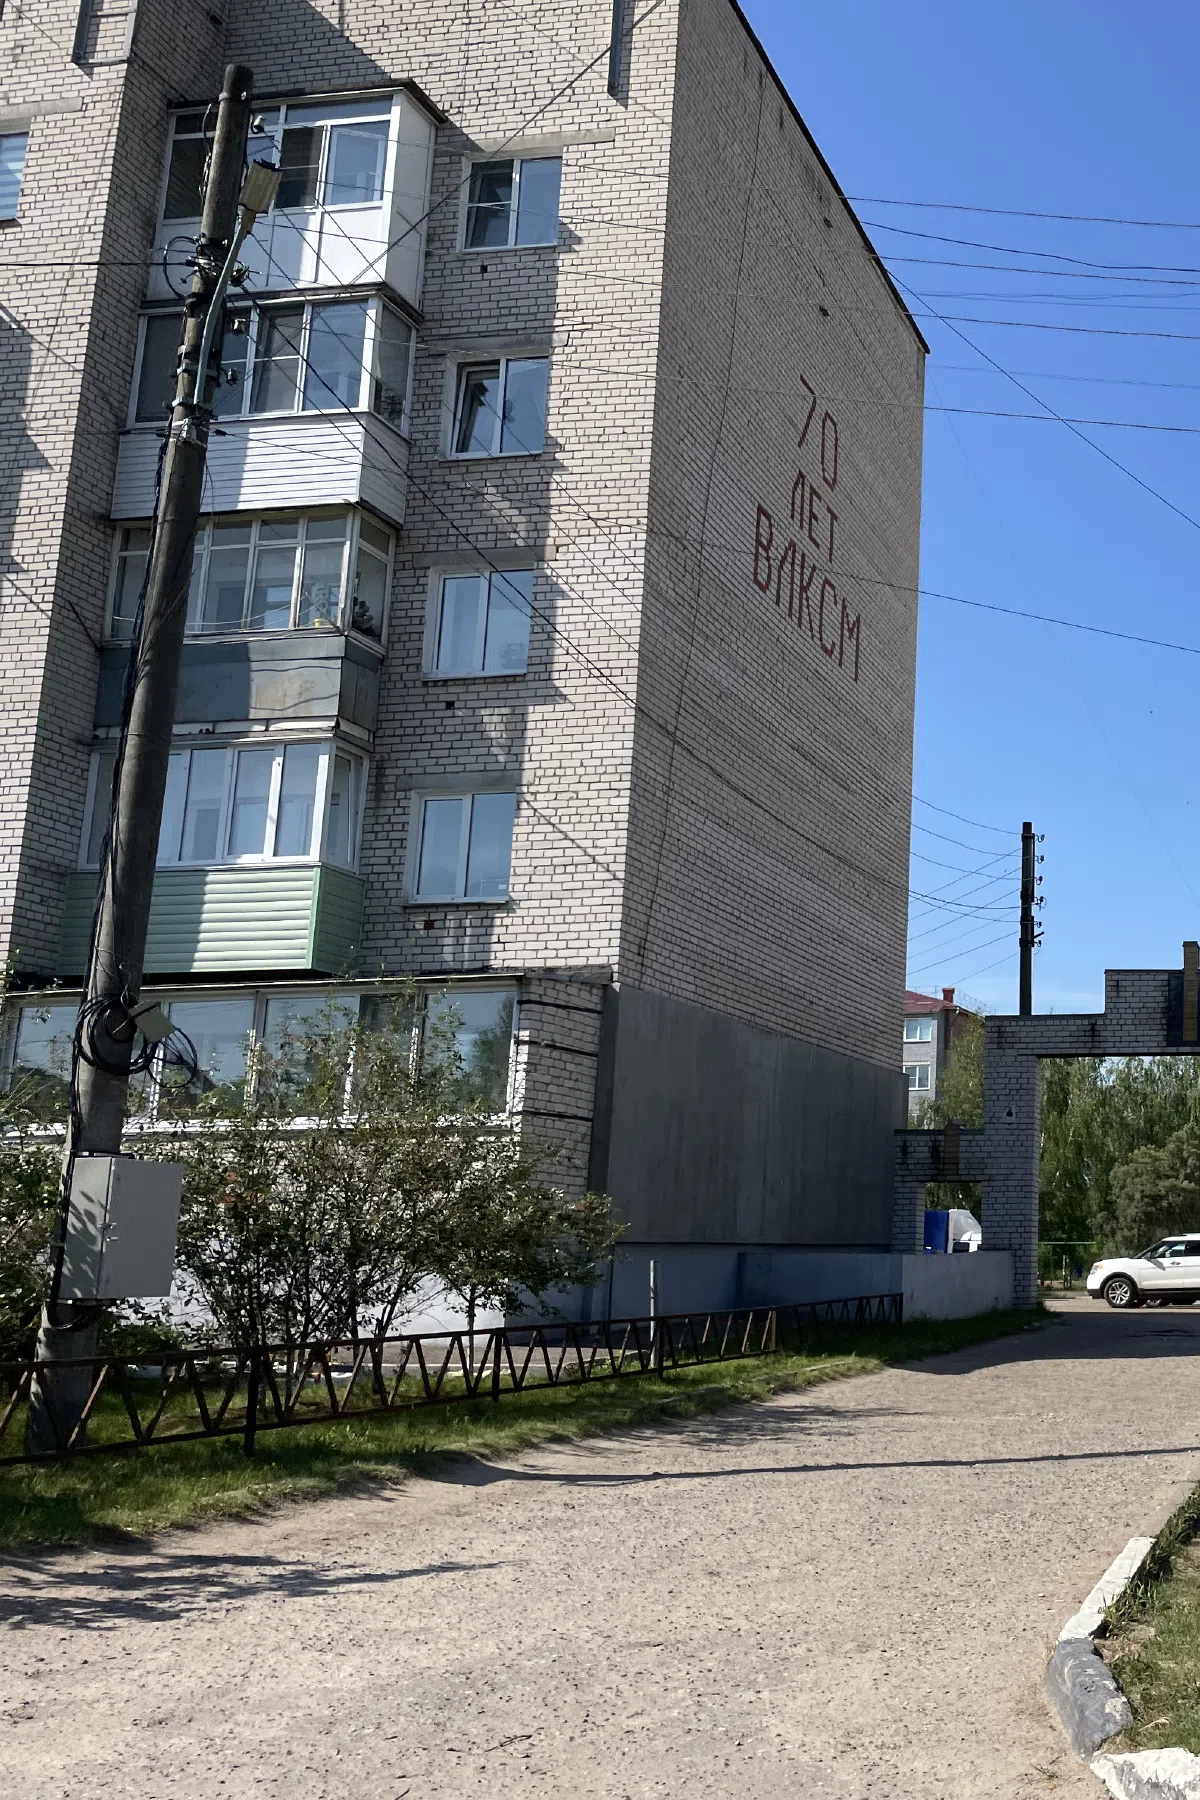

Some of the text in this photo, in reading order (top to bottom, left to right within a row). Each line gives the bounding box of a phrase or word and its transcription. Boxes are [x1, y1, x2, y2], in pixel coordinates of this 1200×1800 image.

[797, 373, 839, 493] 70
[791, 470, 839, 564] ЛЕТ
[753, 502, 861, 684] ВЛКСМ
